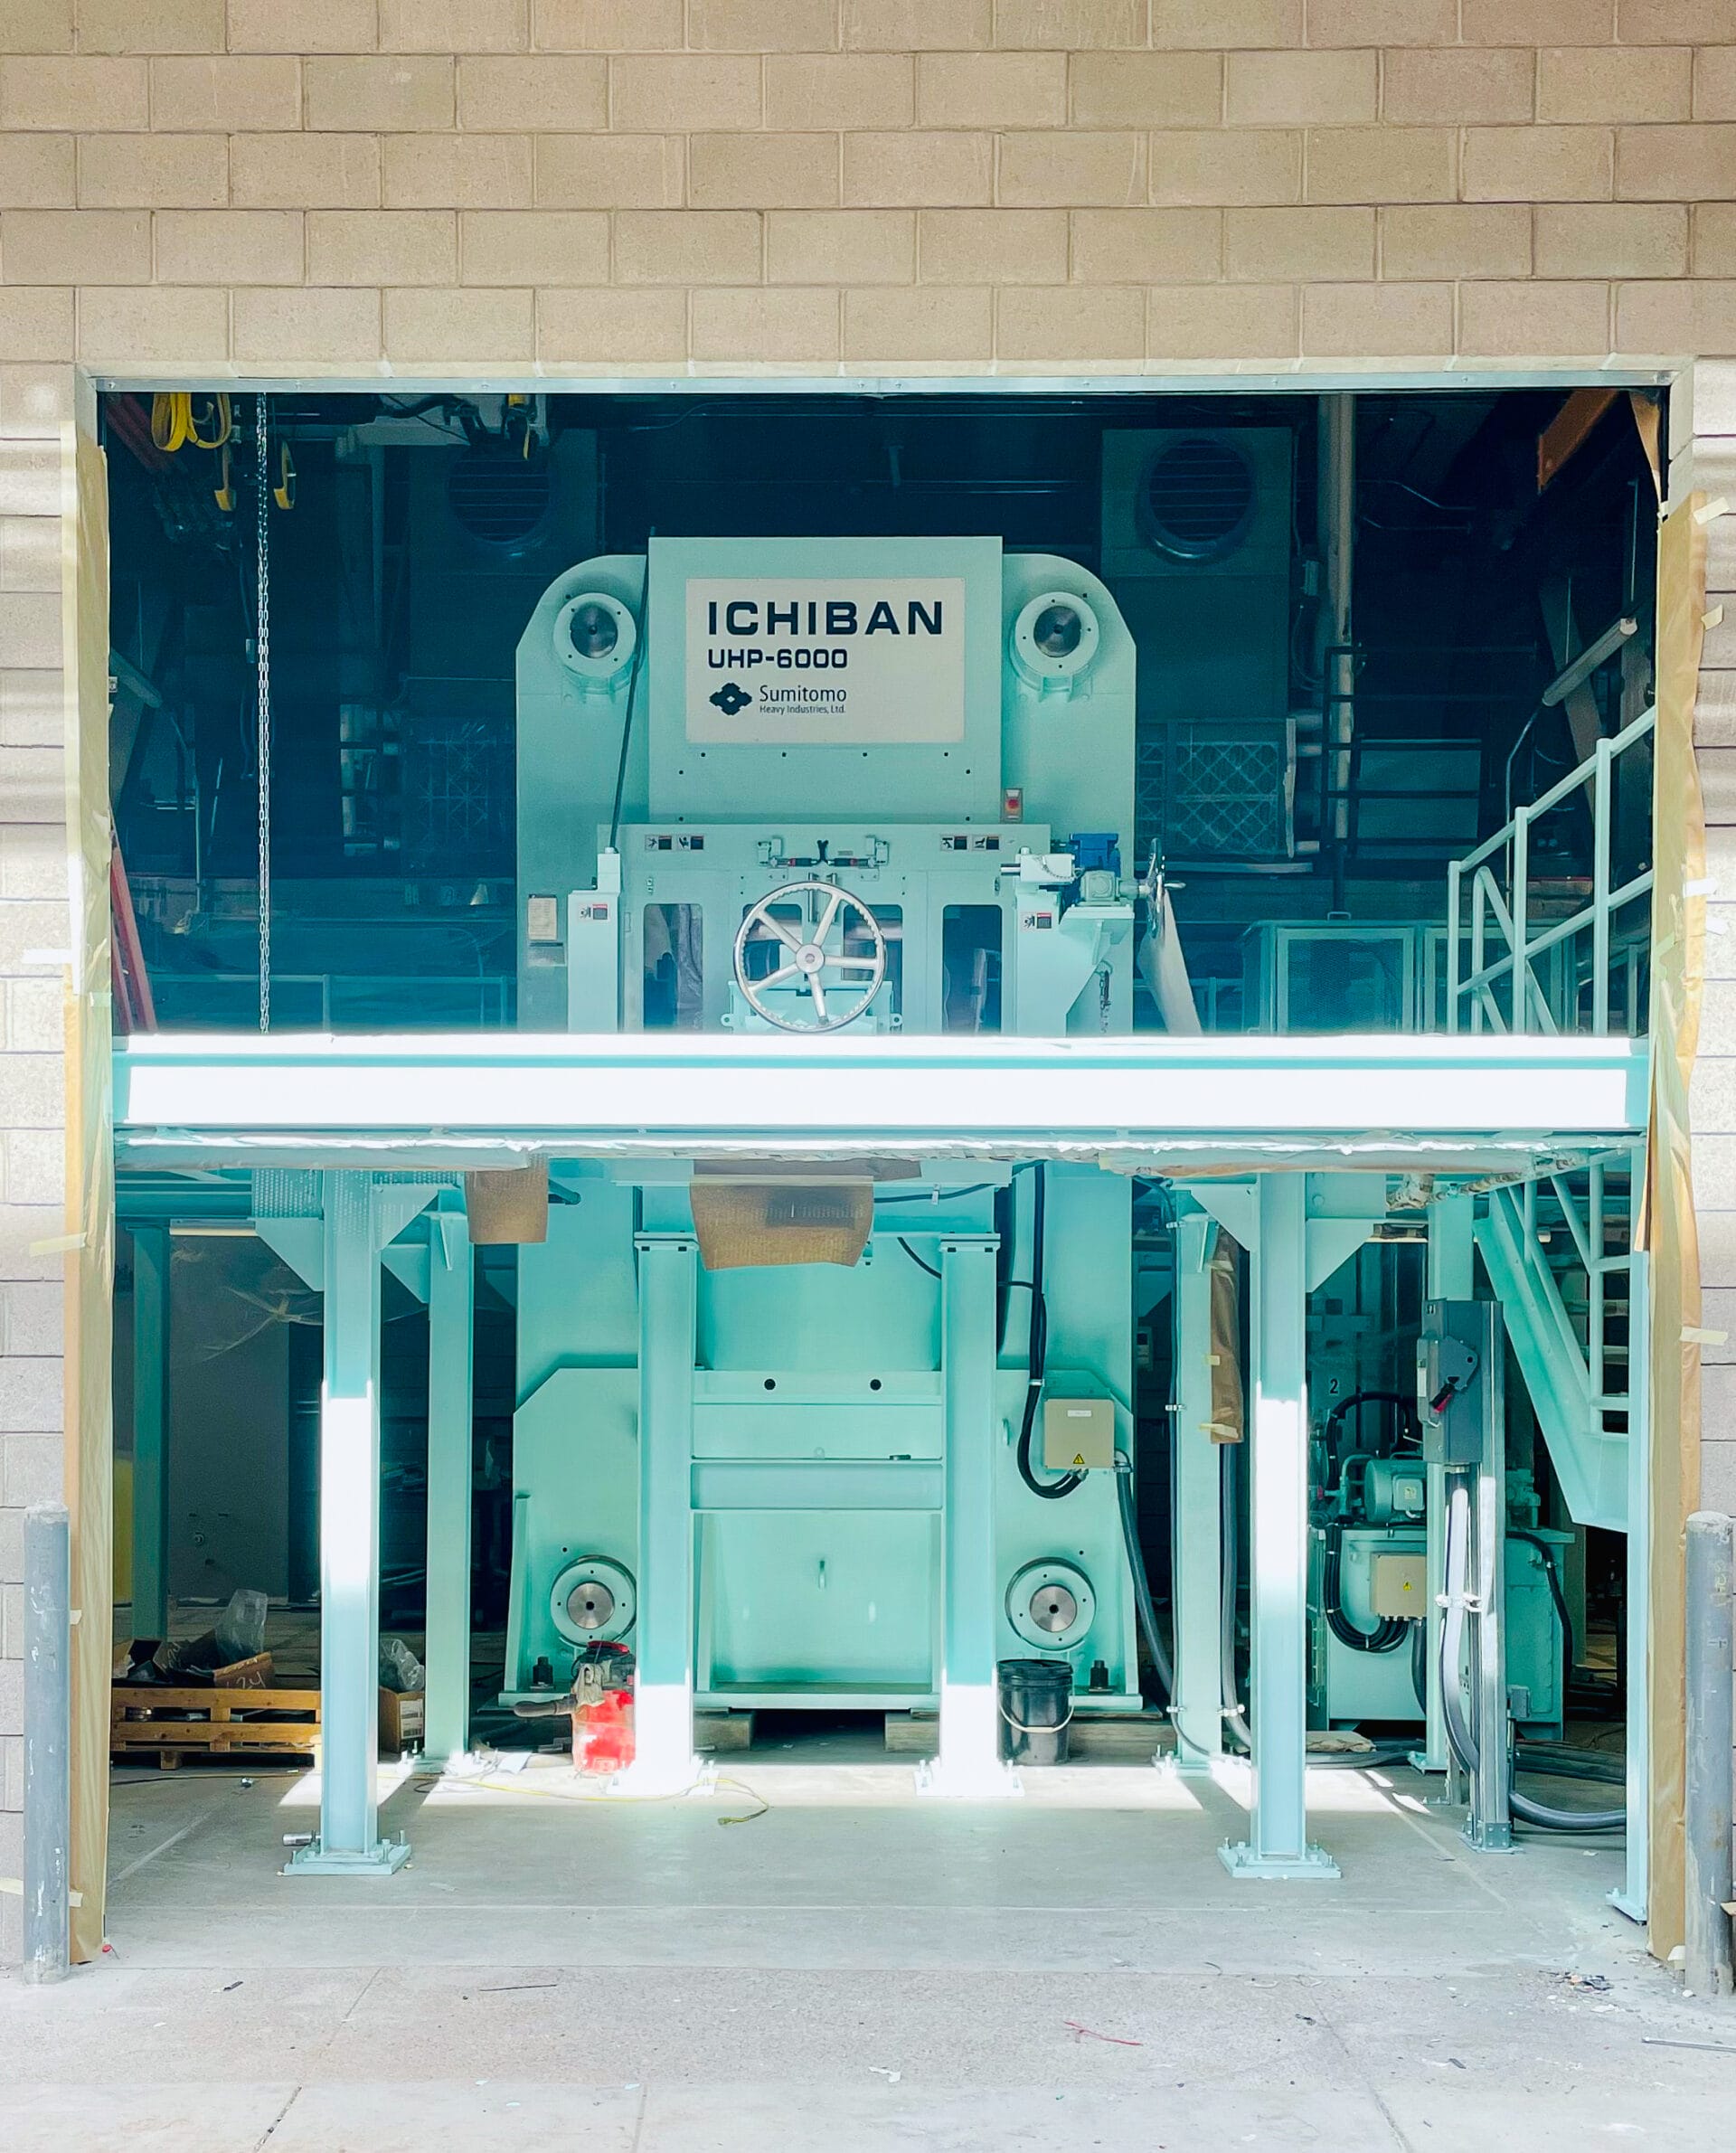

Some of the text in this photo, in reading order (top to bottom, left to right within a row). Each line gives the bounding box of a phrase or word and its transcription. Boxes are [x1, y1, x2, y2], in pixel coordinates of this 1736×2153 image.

[709, 601, 942, 635] ICHIBAN
[708, 649, 848, 668] UHP-6000
[760, 685, 847, 703] Sumitomo
[760, 705, 785, 715] Heavy
[1330, 1379, 1338, 1393] 2
